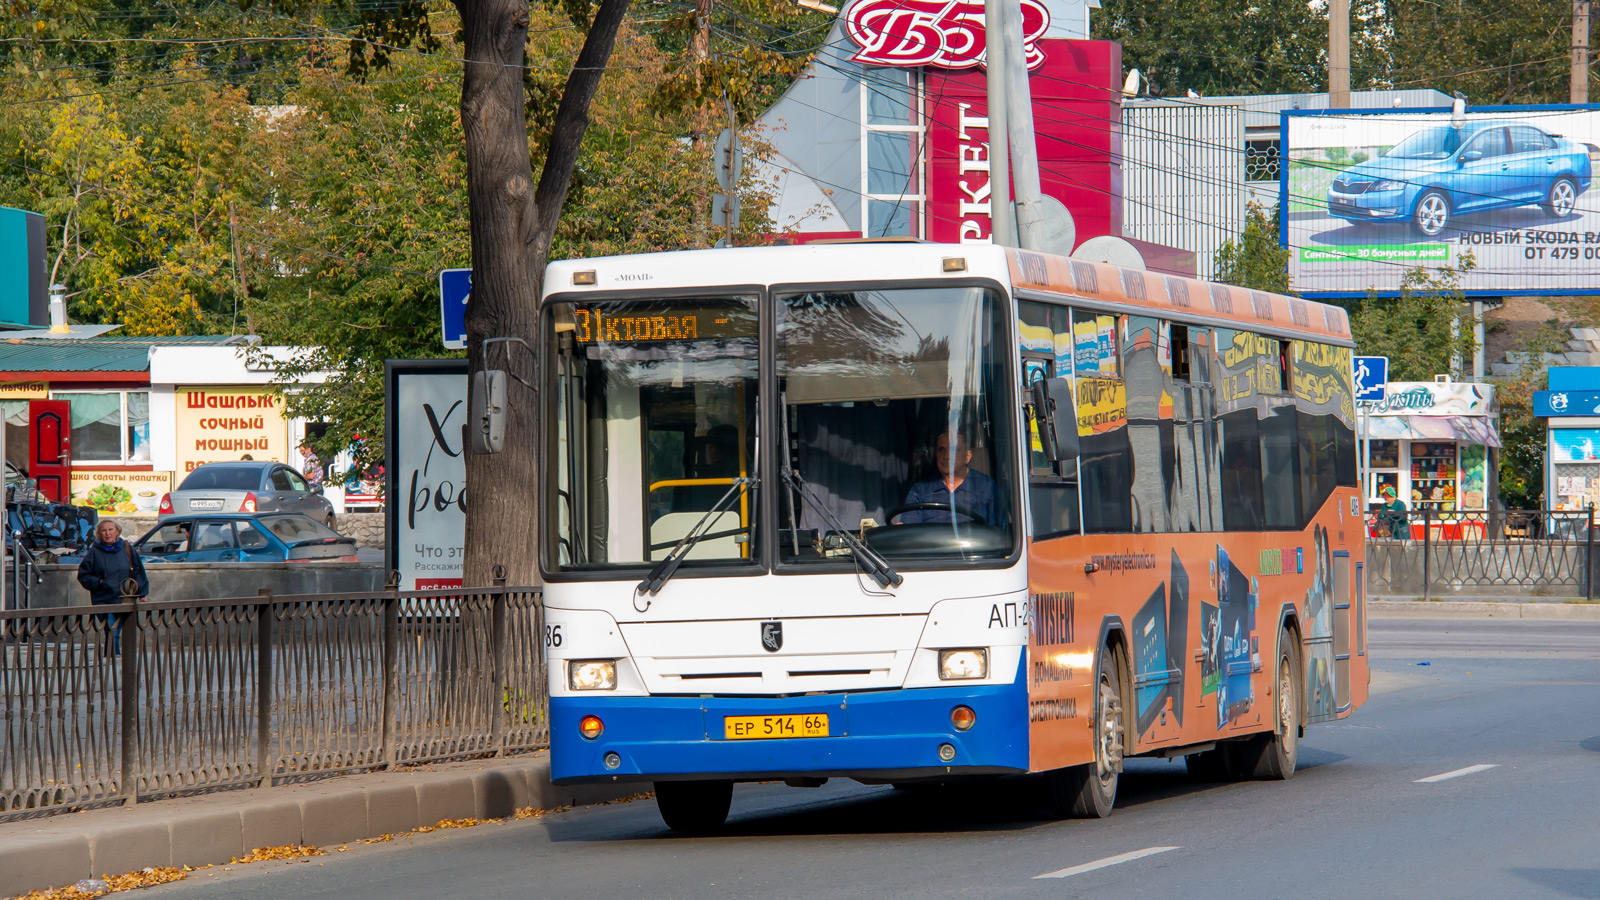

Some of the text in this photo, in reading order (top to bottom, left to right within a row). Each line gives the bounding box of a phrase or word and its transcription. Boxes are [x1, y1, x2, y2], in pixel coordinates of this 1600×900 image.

[1460, 228, 1520, 245] НОВЫЙ
[1304, 250, 1347, 260] Сентябрь
[1358, 249, 1369, 257] 30
[1371, 248, 1417, 260] бонусных
[1419, 248, 1446, 257] дней!
[1525, 247, 1547, 259] ОТ
[1550, 247, 1579, 259] 479
[0, 383, 44, 392] лычная
[187, 391, 274, 409] Шашлык
[199, 415, 264, 430] сочный
[195, 436, 268, 451] мощный
[415, 544, 443, 557] Что
[1036, 592, 1074, 646] MYSTERY
[1030, 697, 1078, 723] ЭЛЕКТРОНИКА
[763, 717, 795, 734] 514
[805, 716, 821, 728] 66
